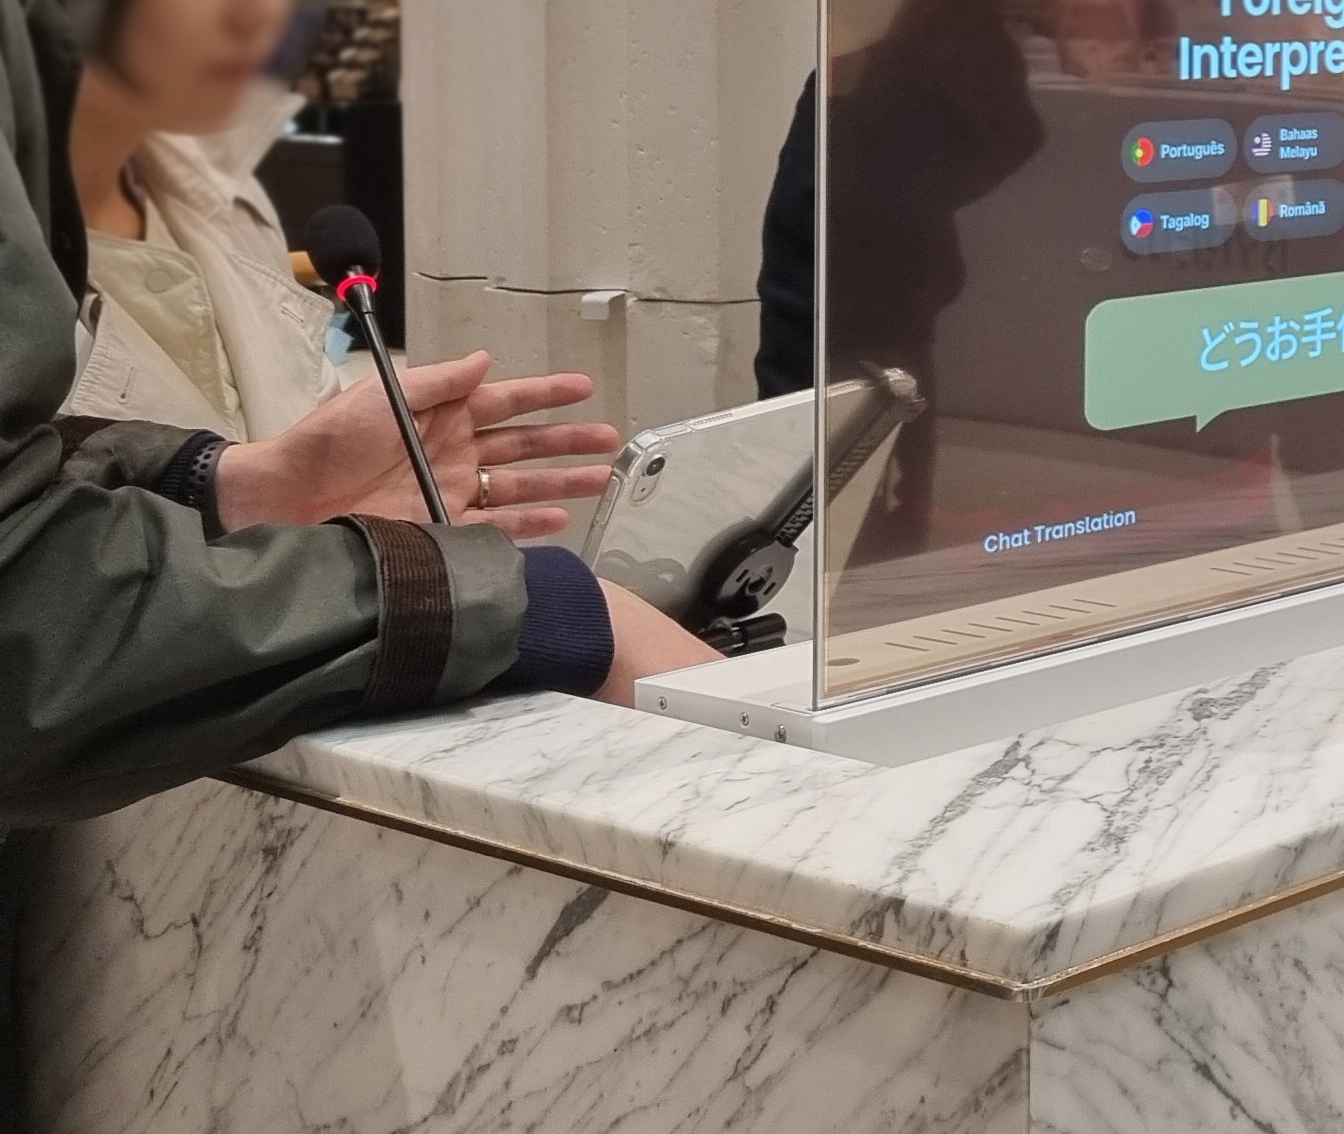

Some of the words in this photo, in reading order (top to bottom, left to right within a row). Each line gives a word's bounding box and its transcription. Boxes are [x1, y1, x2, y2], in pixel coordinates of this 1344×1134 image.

[1280, 128, 1318, 142] Bahaas
[1161, 140, 1225, 160] Português
[1280, 146, 1318, 160] Melayu
[1280, 201, 1326, 218] Română
[1160, 213, 1210, 232] Tagalog
[983, 524, 1030, 555] Chat
[1035, 507, 1137, 545] Translation
